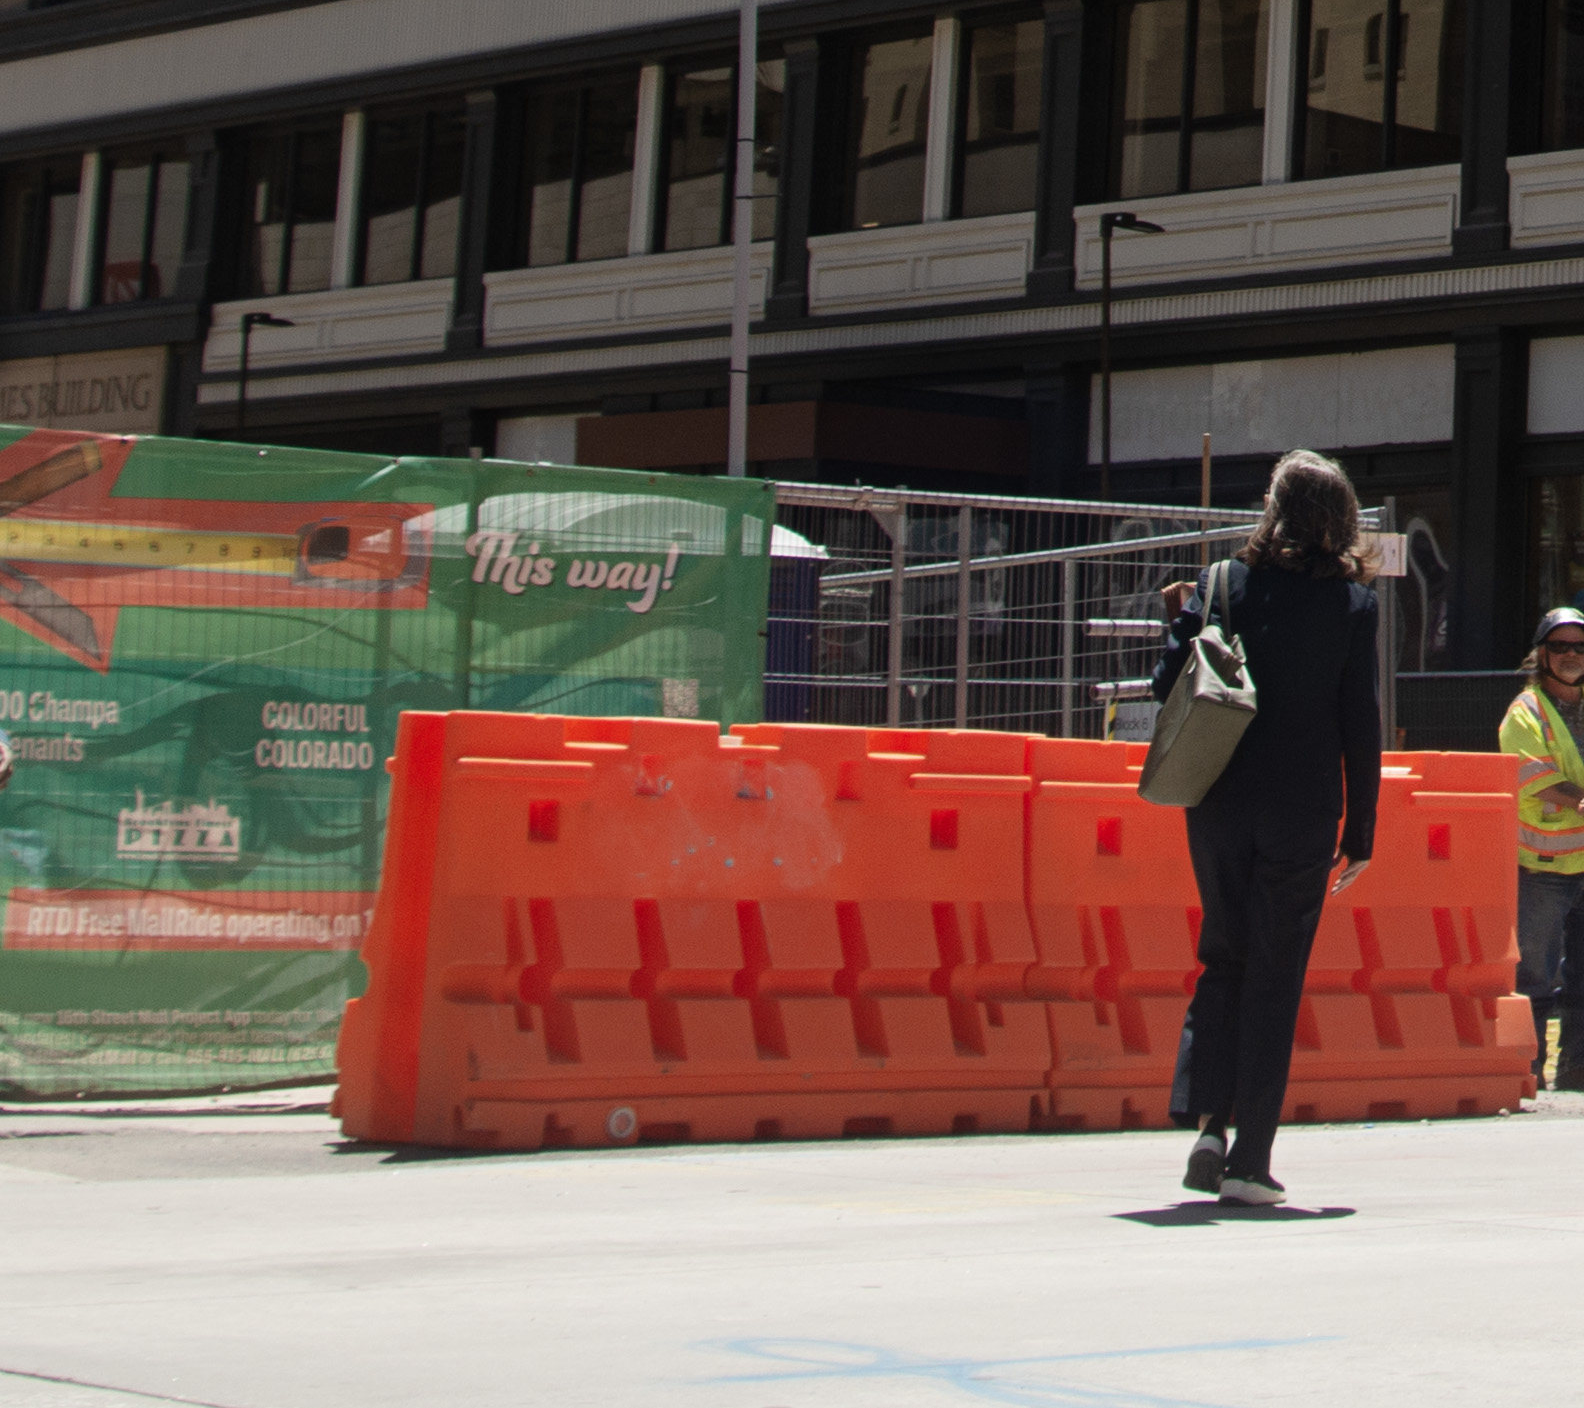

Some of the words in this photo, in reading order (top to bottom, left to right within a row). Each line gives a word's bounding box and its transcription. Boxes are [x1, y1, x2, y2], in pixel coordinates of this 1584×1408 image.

[38, 373, 152, 419] BUILDING
[464, 530, 558, 595] This
[566, 541, 680, 615] way!
[28, 690, 121, 731] Champa
[262, 700, 370, 733] COLORFUL
[6, 731, 86, 763] enants
[254, 739, 375, 771] COLORADO
[124, 829, 234, 846] PIZZA
[26, 906, 74, 936] RTD
[75, 907, 124, 937] Free
[126, 907, 224, 938] MallRide
[226, 909, 330, 943] operating
[333, 914, 362, 938] on
[90, 1008, 135, 1026] Street
[171, 1009, 220, 1028] Project
[223, 1009, 251, 1028] App
